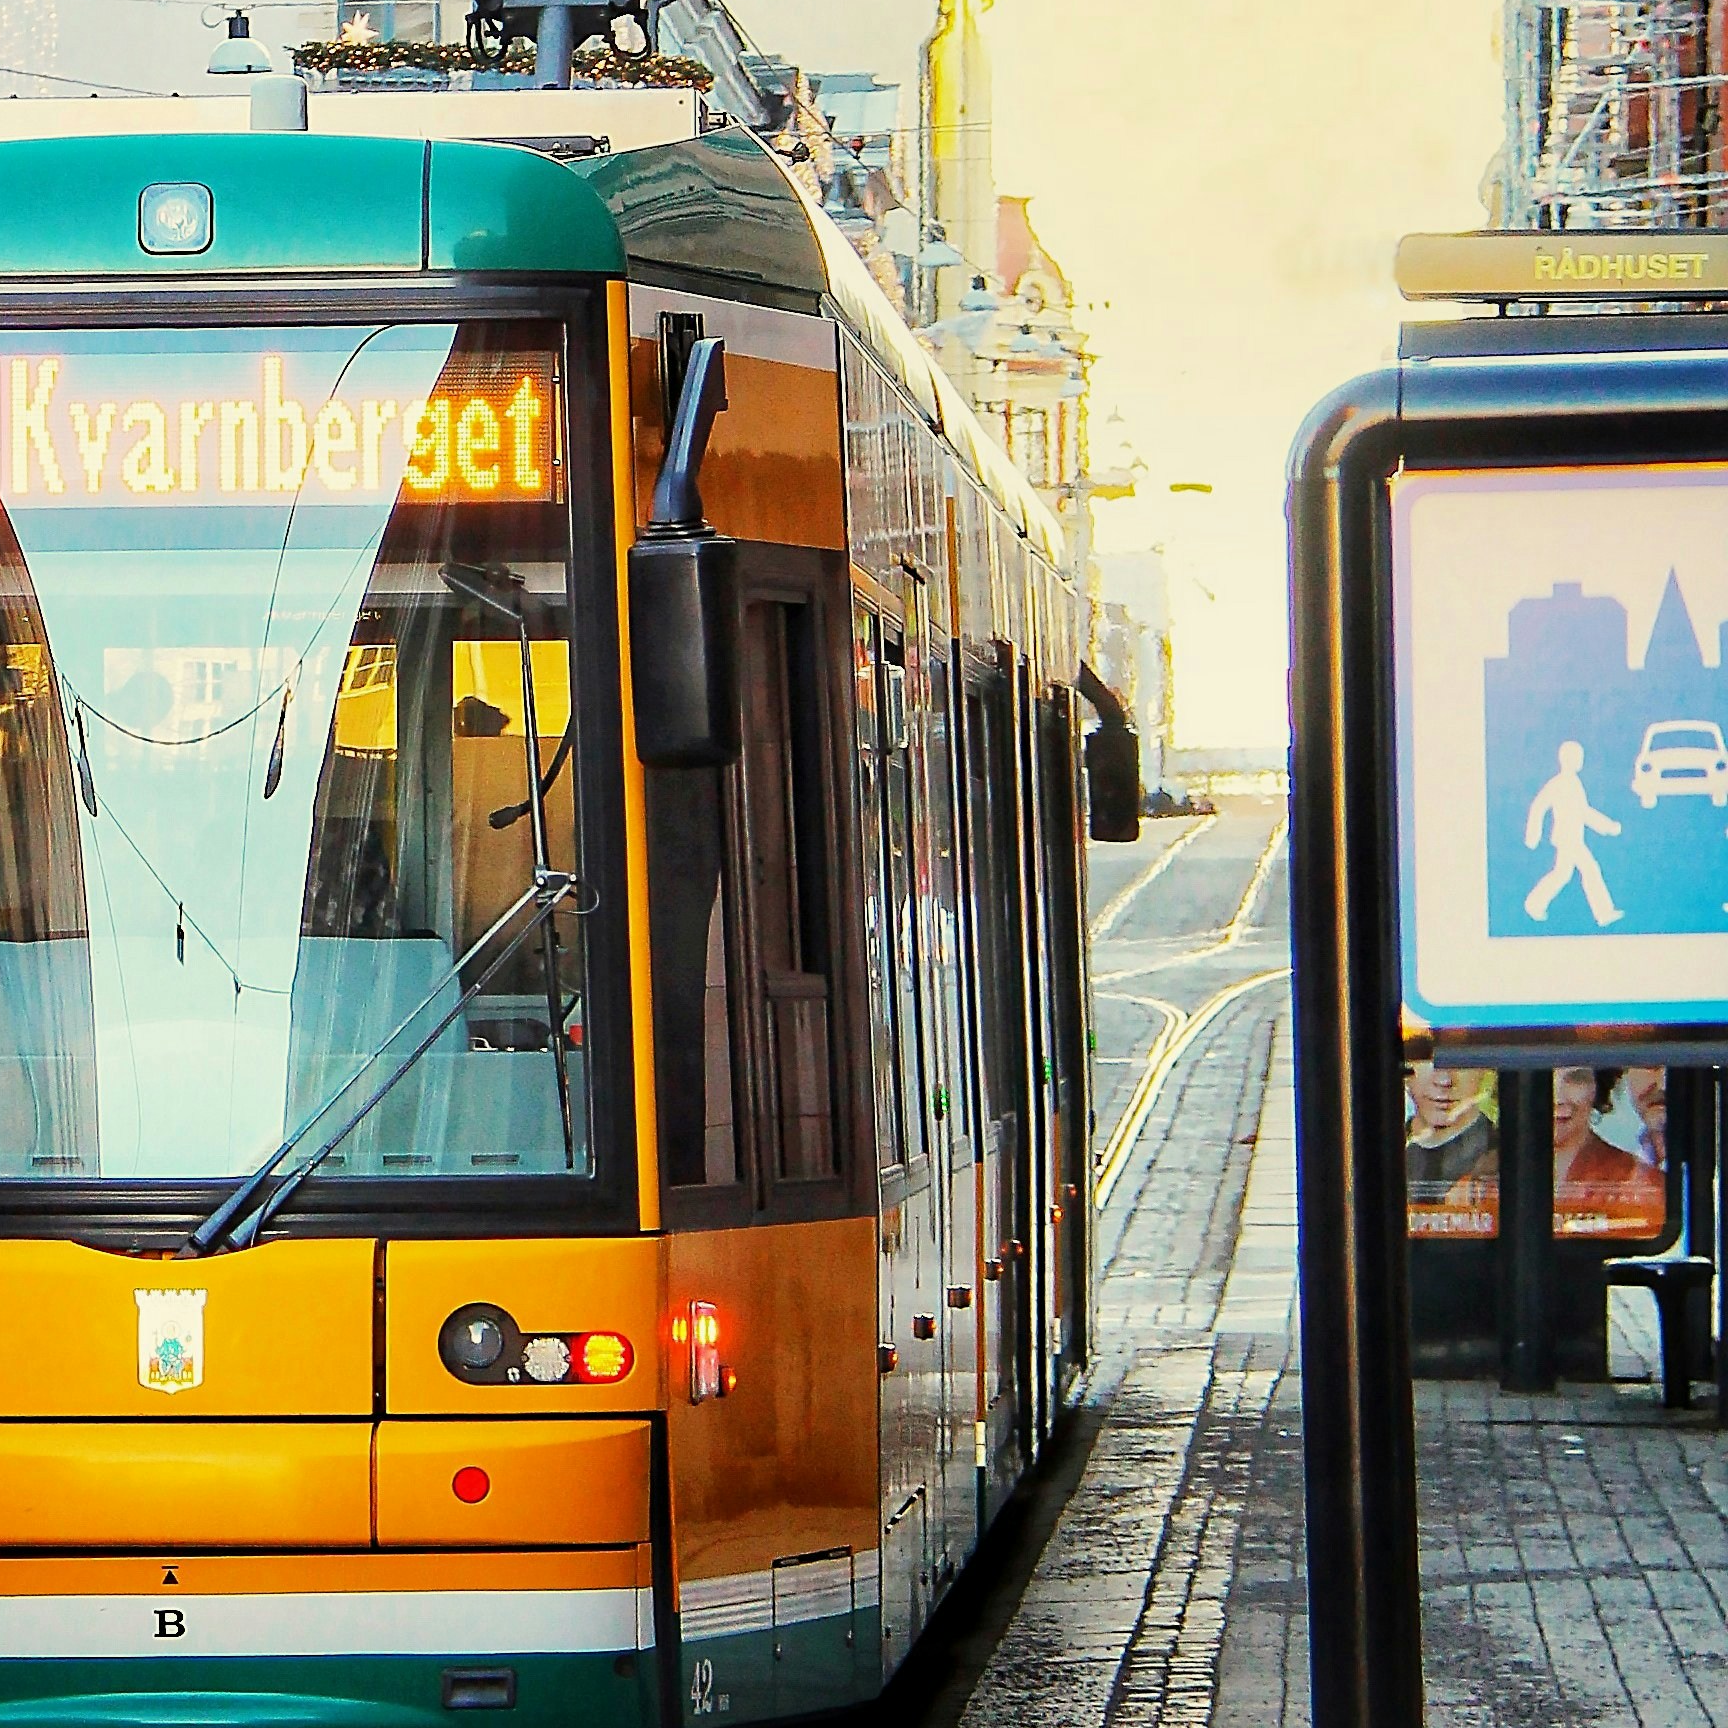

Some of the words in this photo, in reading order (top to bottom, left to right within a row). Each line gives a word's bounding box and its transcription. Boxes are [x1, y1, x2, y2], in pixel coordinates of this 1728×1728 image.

[1534, 247, 1709, 279] RÅDHUSET
[13, 356, 541, 494] Kvarnberget
[154, 1610, 185, 1637] B
[691, 1659, 713, 1715] 42
